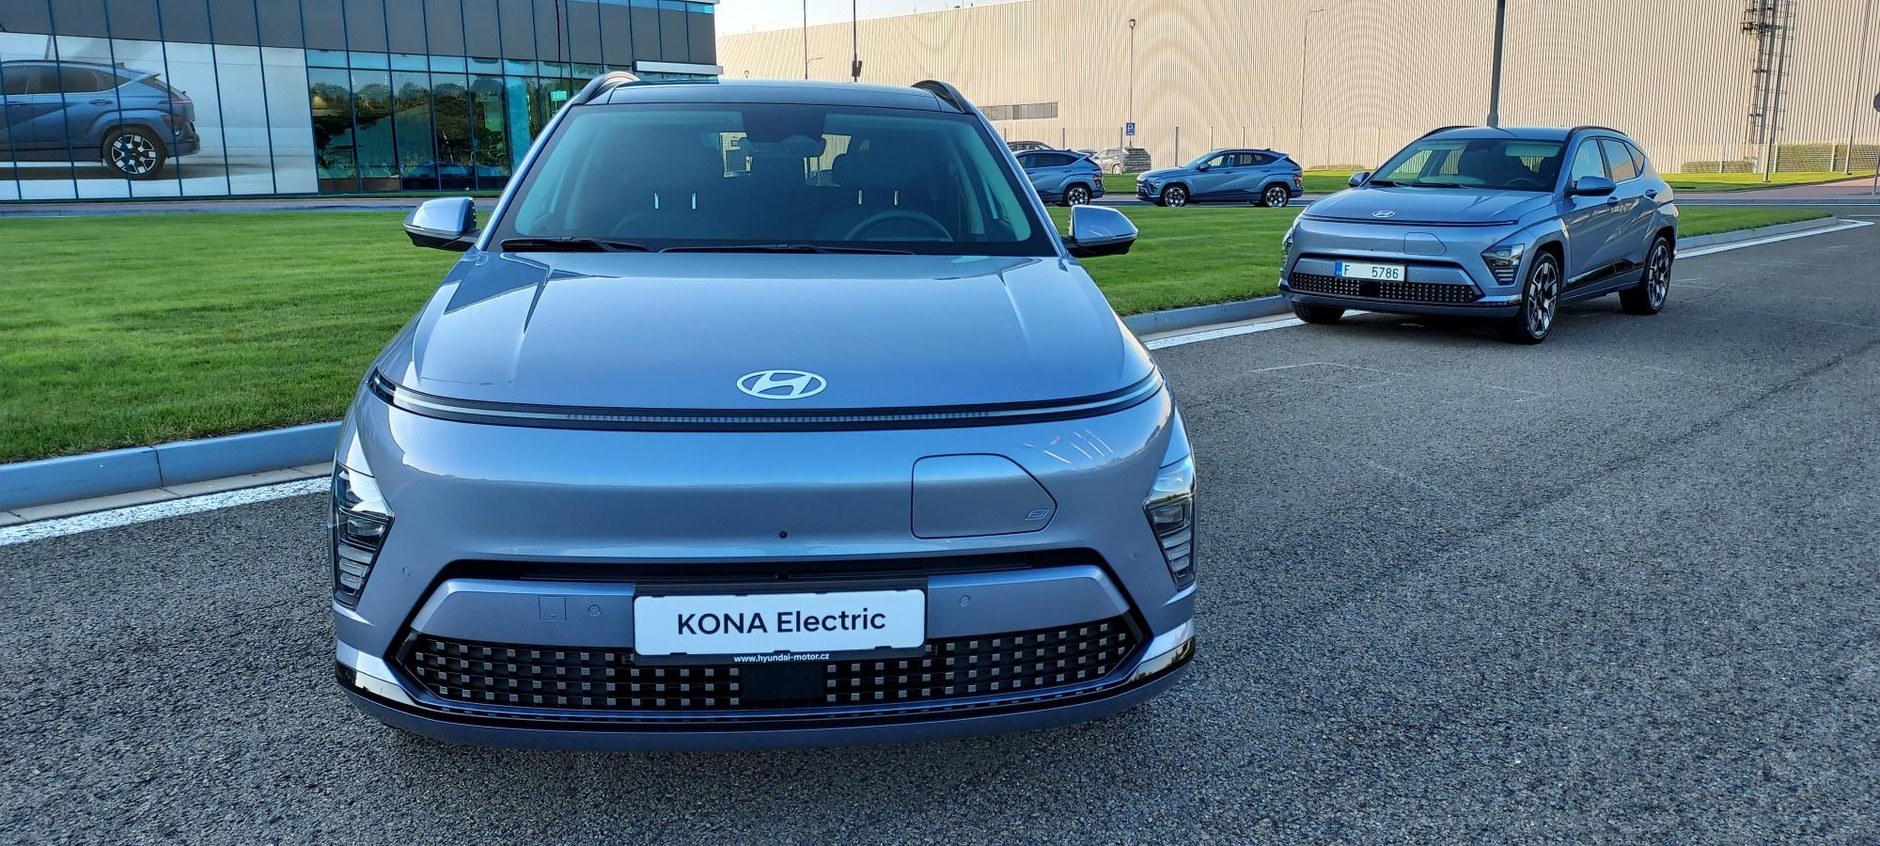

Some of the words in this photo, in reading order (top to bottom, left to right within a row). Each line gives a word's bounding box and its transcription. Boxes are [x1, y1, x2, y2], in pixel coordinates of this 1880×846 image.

[1344, 264, 1351, 275] F
[1371, 266, 1399, 279] 5786
[677, 612, 768, 635] KONA
[777, 607, 886, 633] Electric
[733, 653, 830, 663] www.hyundai-motor.cz
